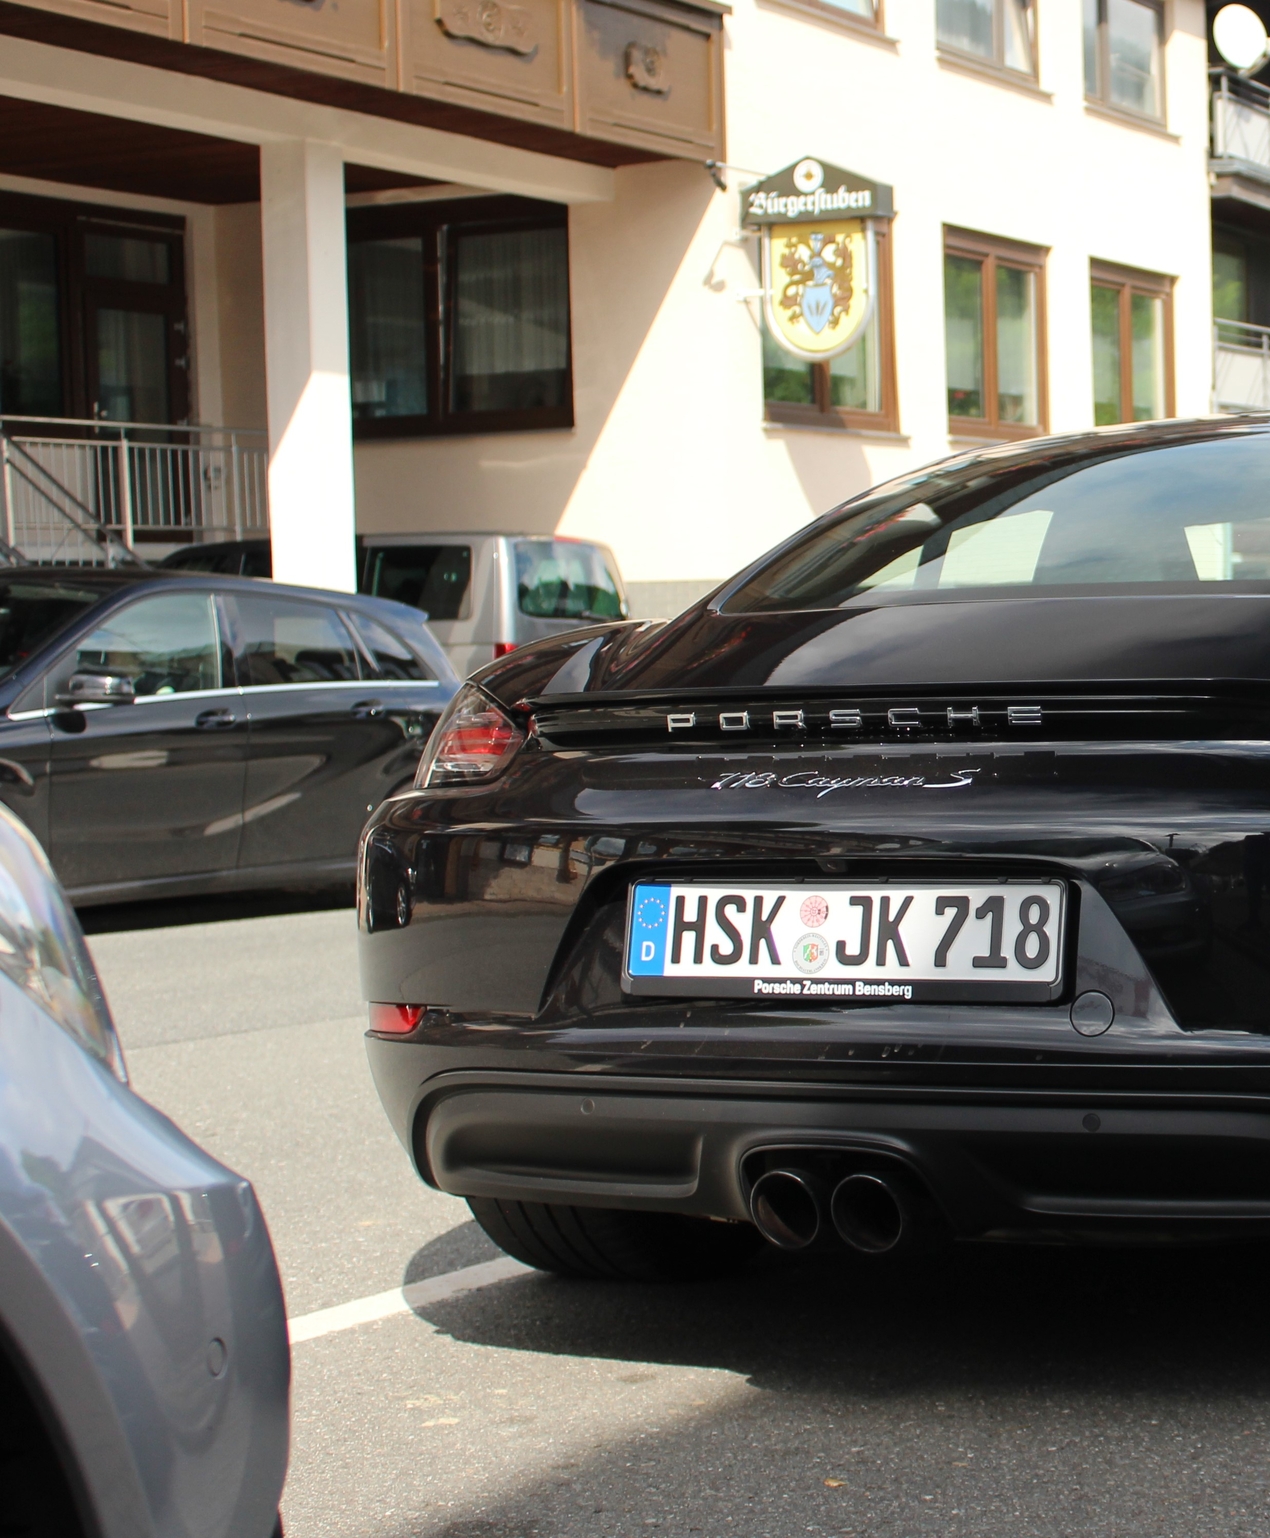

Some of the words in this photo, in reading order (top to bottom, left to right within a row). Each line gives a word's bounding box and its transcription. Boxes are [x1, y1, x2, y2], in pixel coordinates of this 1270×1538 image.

[666, 705, 1043, 733] PORSCHE
[711, 771, 777, 790] 718
[778, 771, 925, 799] Cayman
[922, 768, 982, 789] S
[640, 940, 656, 962] D
[670, 894, 787, 966] HSK
[835, 895, 914, 967] JK
[934, 895, 1050, 970] 718
[753, 979, 801, 995] Porsche
[802, 980, 854, 996] Zentrum
[854, 981, 913, 999] Bensberg
